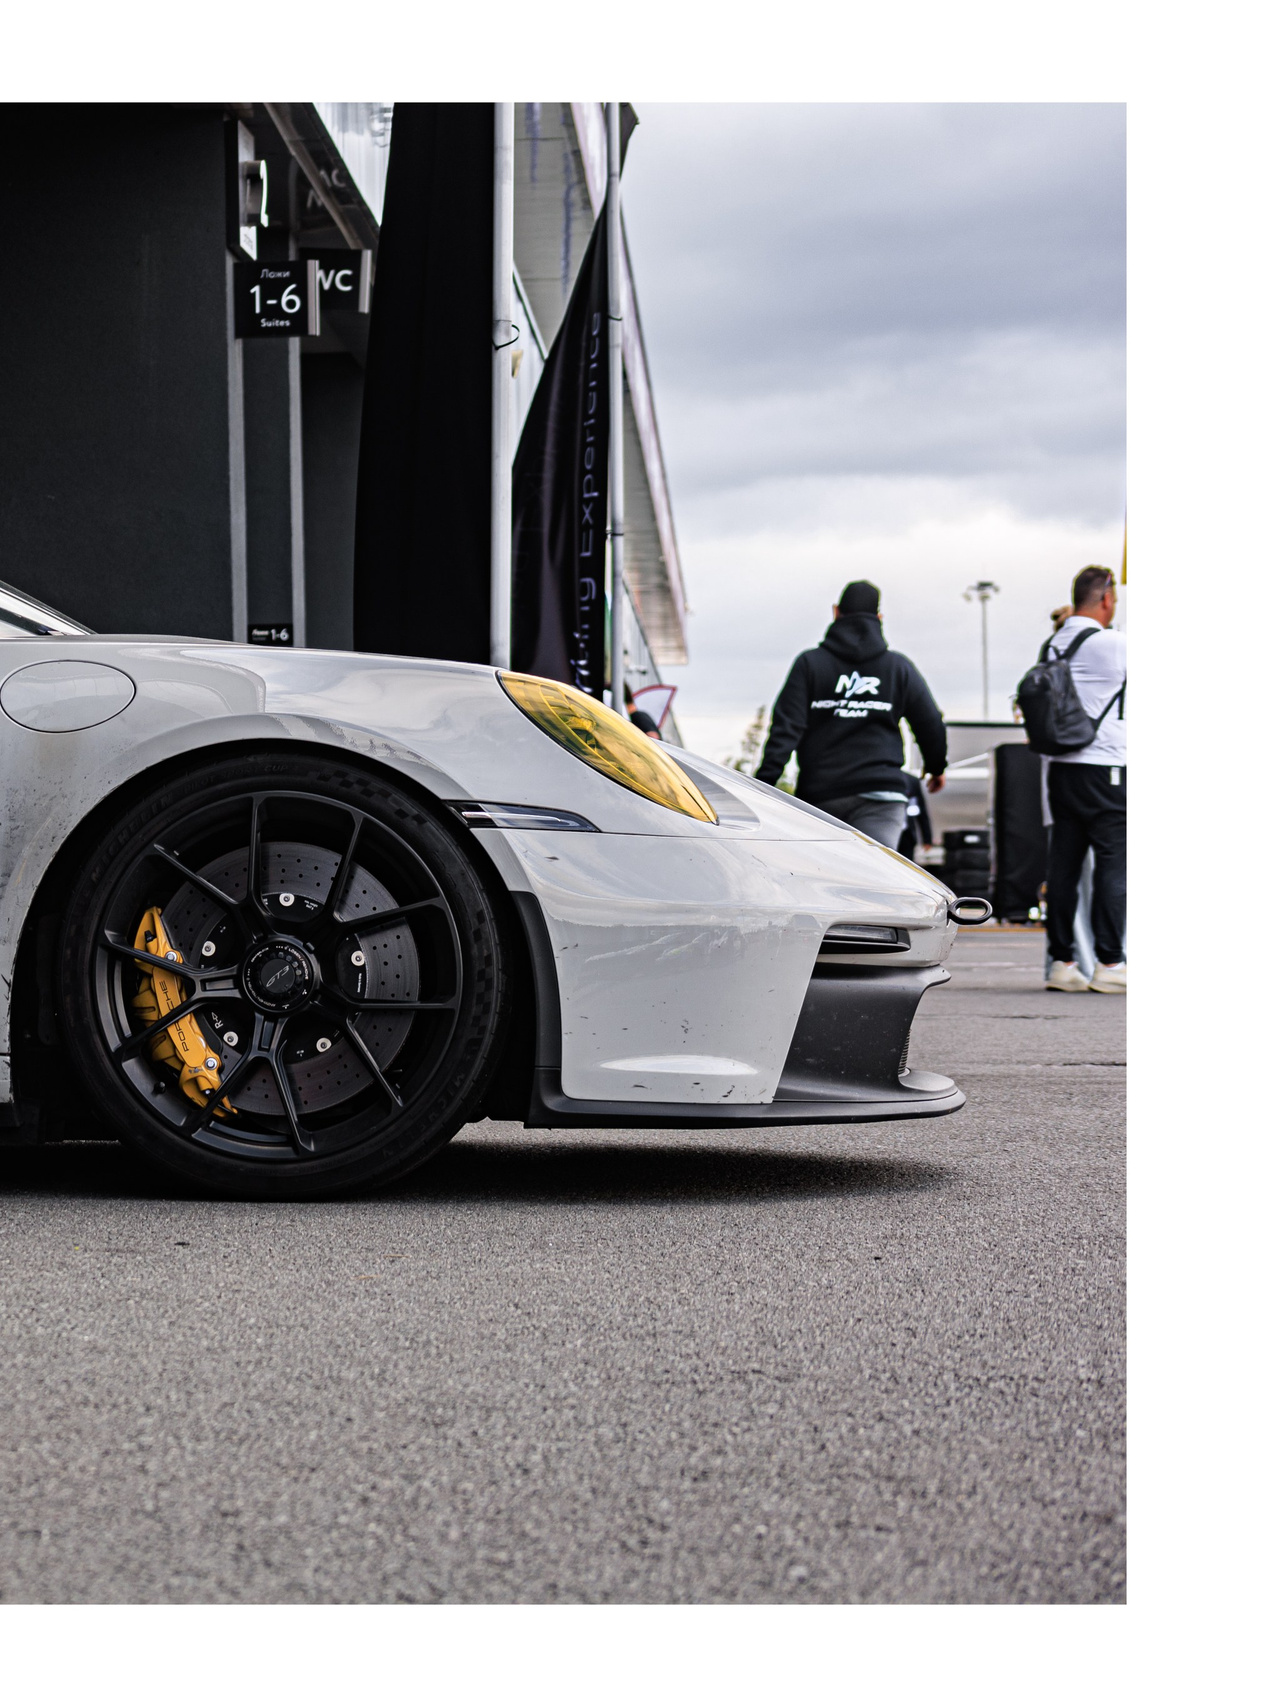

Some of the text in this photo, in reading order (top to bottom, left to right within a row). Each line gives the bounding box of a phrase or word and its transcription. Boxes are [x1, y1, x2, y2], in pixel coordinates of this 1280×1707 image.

[260, 269, 291, 279] Ложи
[250, 284, 301, 314] 1-6
[261, 318, 290, 327] Suites
[834, 708, 868, 717] TEAM
[159, 980, 190, 1052] PORCHE
